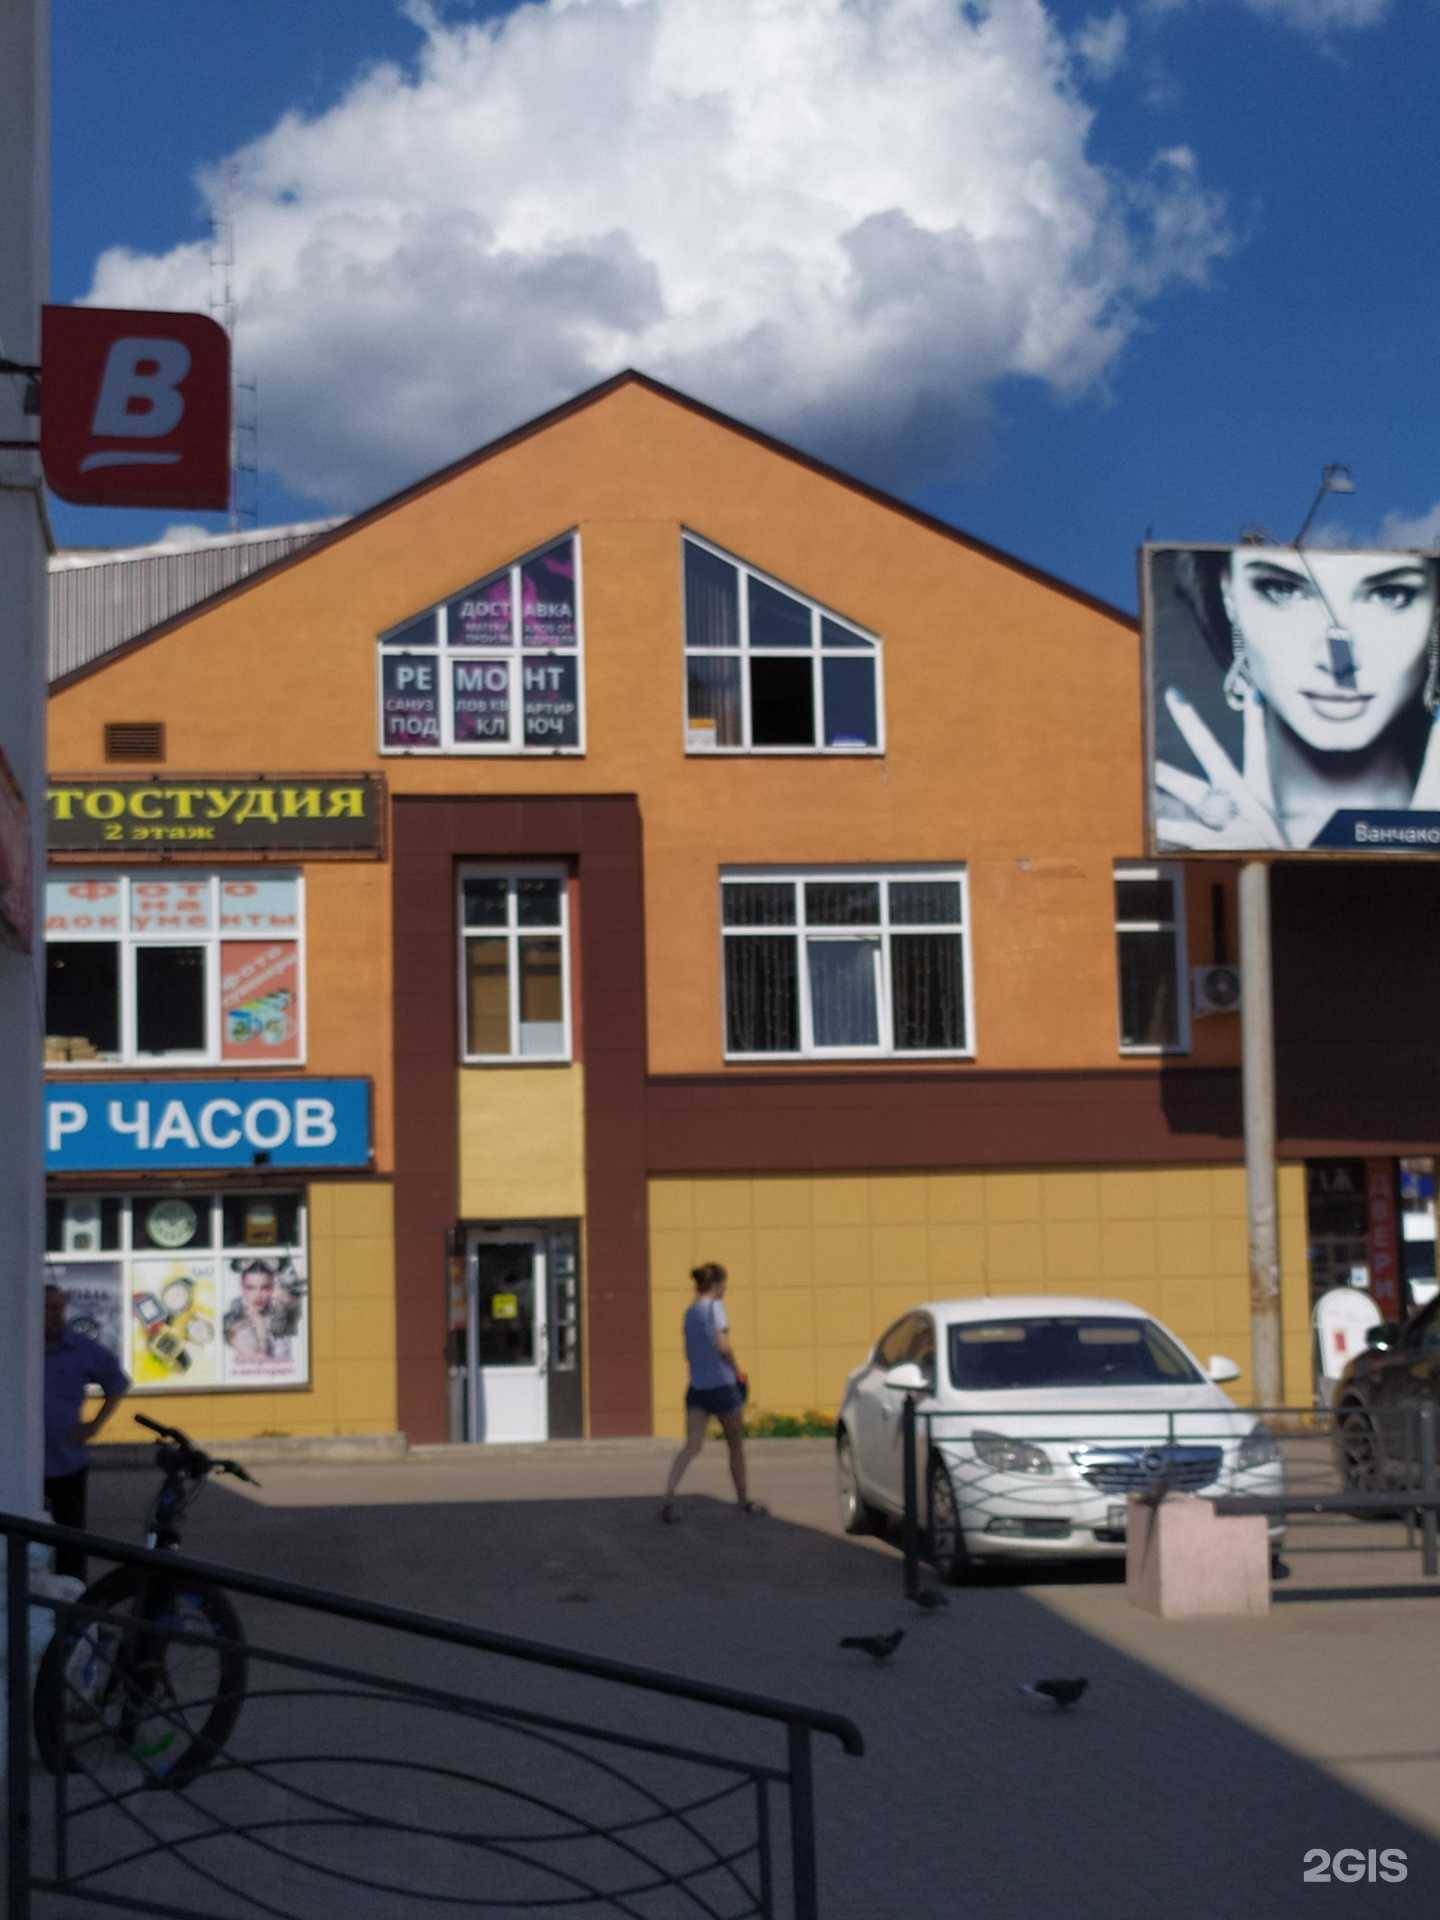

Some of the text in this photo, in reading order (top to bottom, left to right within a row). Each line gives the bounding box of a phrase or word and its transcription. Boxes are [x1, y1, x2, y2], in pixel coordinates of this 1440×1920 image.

[461, 602, 572, 618] ДОСТАВКА
[396, 666, 564, 692] РЕМОНТ
[391, 717, 564, 738] ПОД КЛЮЧ
[46, 788, 365, 823] ТОСТУДИЯ
[104, 823, 215, 840] 2 этаж
[1355, 822, 1440, 843] Ванчако
[48, 1099, 337, 1151] Р ЧАСОВ
